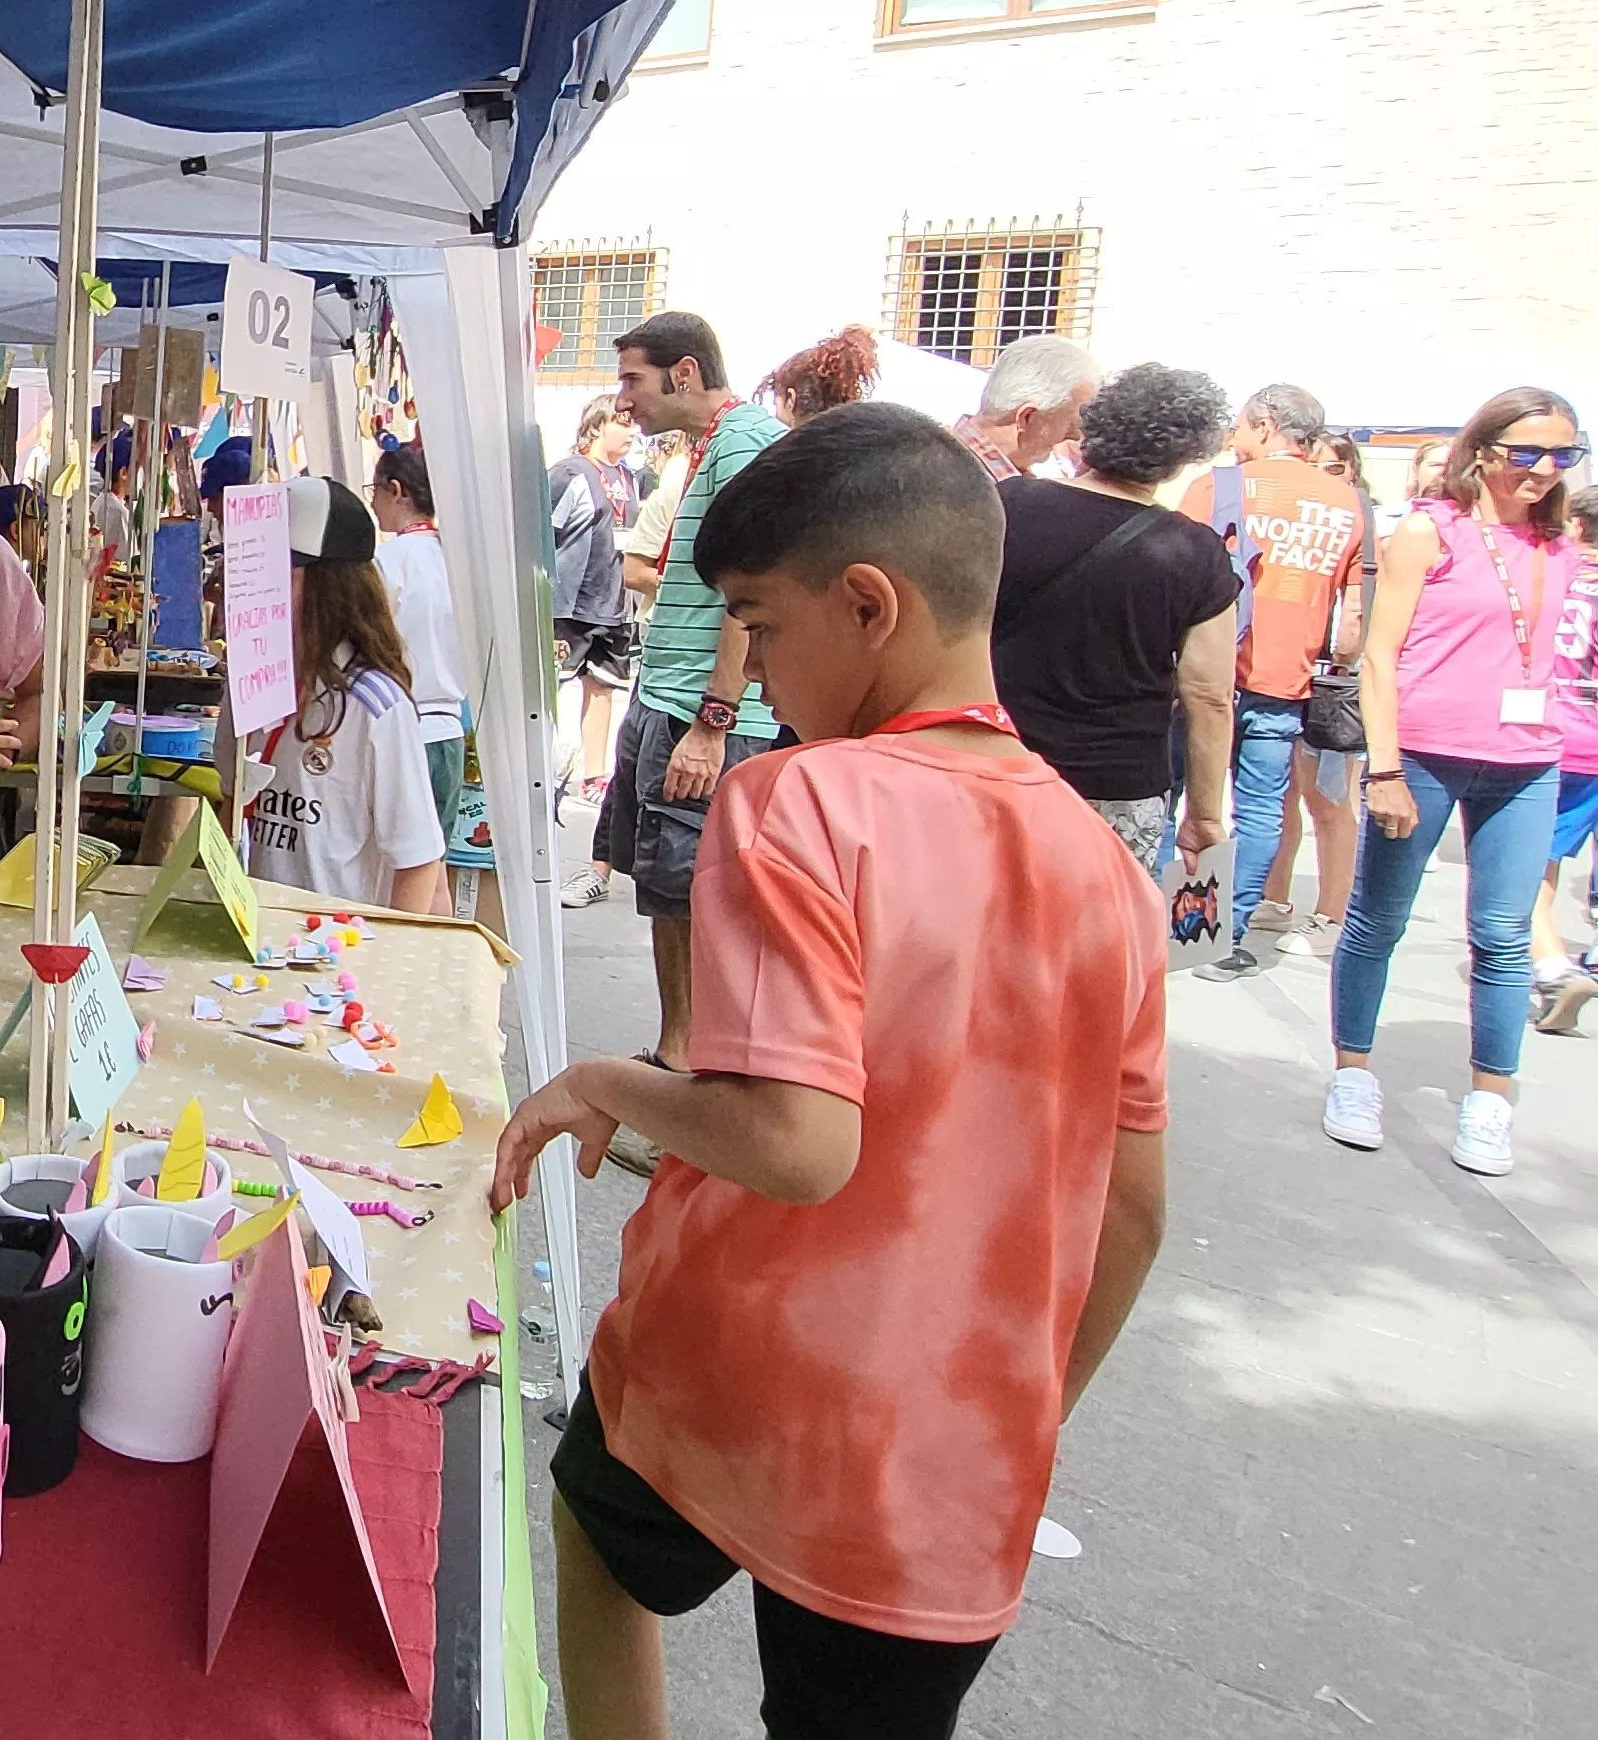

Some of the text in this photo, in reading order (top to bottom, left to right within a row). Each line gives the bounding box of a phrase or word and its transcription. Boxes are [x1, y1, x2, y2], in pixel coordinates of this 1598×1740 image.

[248, 290, 291, 350] 02
[1245, 514, 1352, 555] NORTH
[1295, 499, 1355, 534] THE
[1268, 541, 1342, 577] FACE
[251, 637, 267, 657] TU
[252, 816, 298, 852] ETTER
[75, 988, 107, 1049] GAFAS
